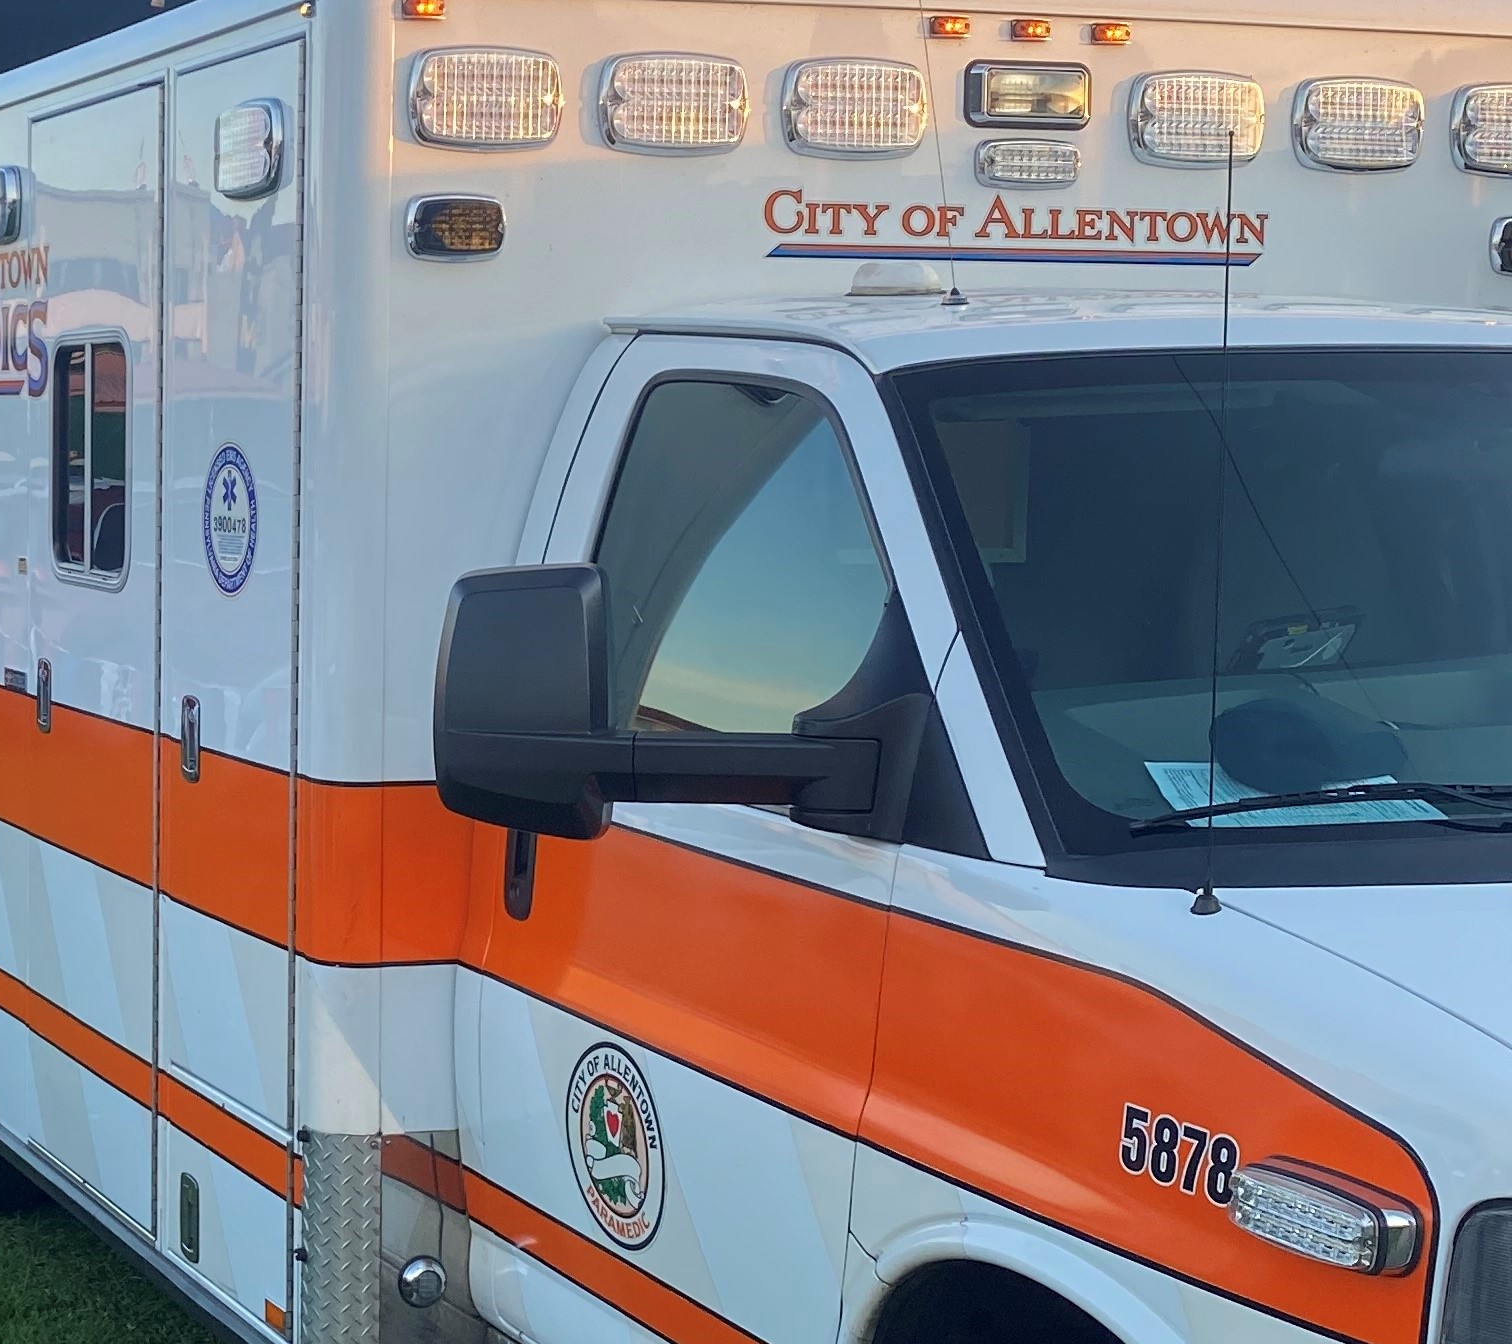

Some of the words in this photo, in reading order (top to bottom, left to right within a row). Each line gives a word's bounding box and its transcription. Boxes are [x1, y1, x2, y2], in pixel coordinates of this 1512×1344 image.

[764, 189, 889, 235] CITY
[902, 205, 965, 237] OF
[976, 194, 1268, 245] ALLENTOWN
[571, 1070, 588, 1114] CITY
[586, 1055, 601, 1075] OF
[603, 1053, 658, 1150] ALLENTOWN
[1121, 1104, 1238, 1206] 5878
[586, 1184, 651, 1239] PARAMEDIC
